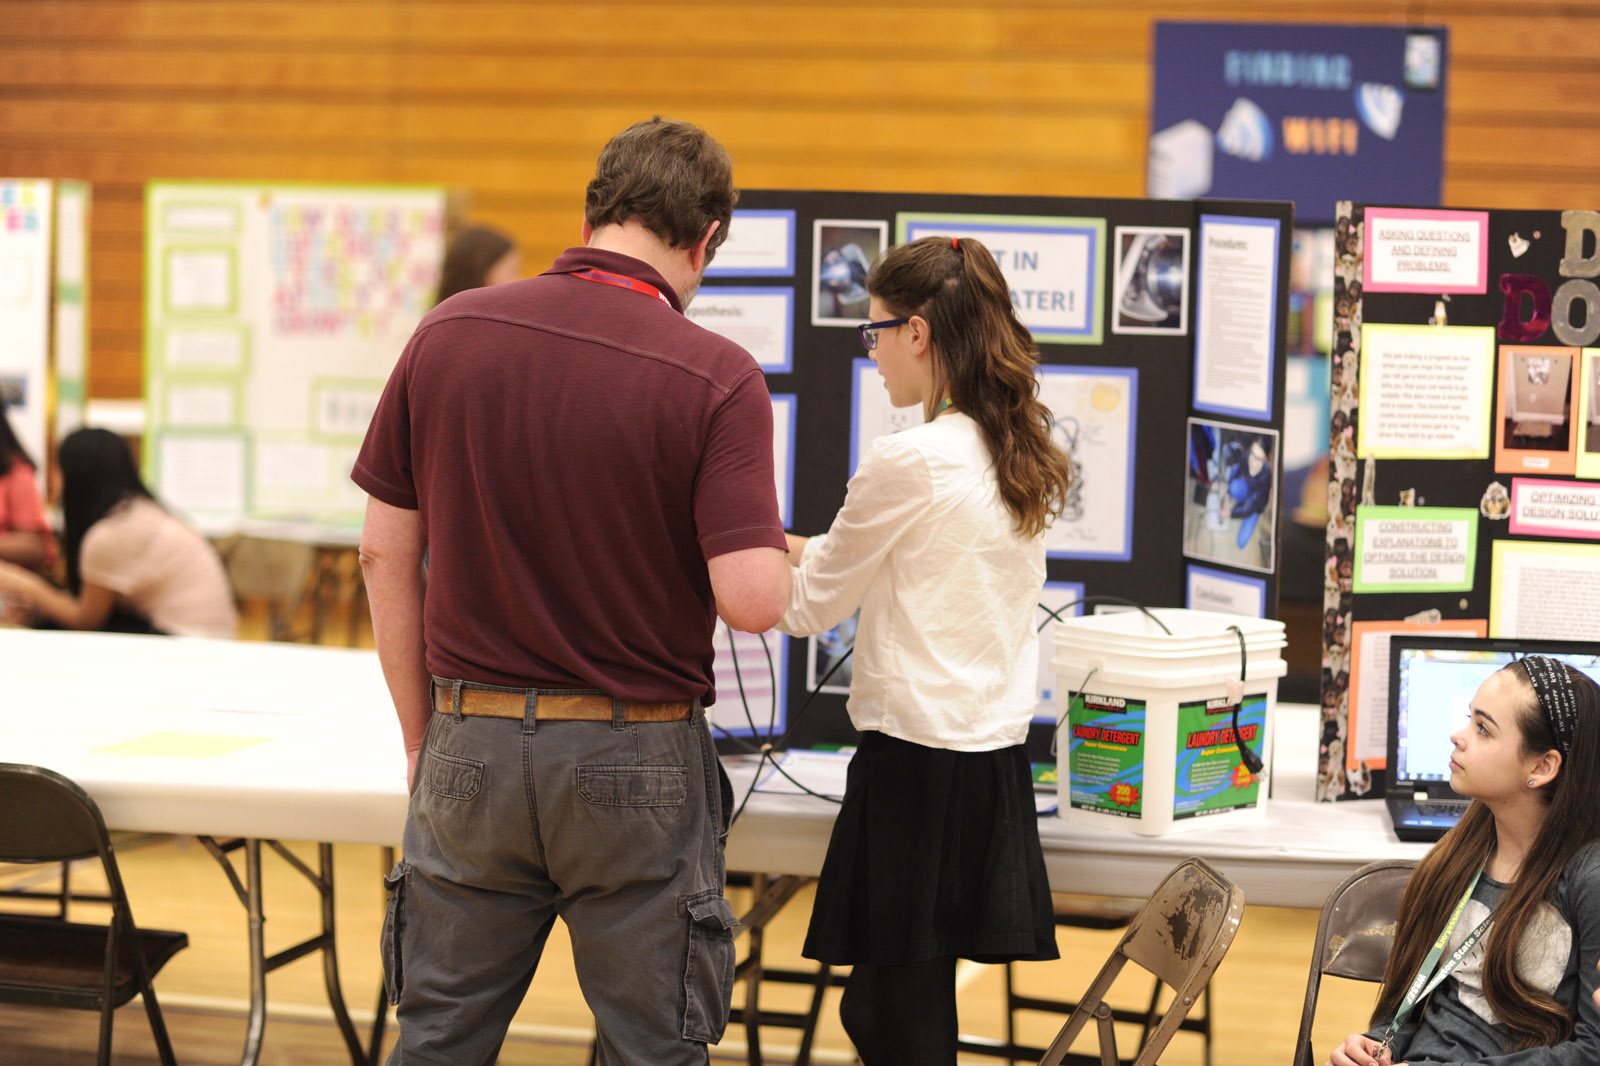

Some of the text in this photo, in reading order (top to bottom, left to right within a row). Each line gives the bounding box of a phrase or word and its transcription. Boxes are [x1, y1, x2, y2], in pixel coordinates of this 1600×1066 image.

[1224, 50, 1352, 90] FINDING
[1282, 117, 1358, 155] WIFI
[1379, 229, 1470, 242] ASKING QUESTIONS
[1391, 245, 1457, 258] AND DEFINING
[1014, 251, 1038, 270] IN
[1010, 290, 1074, 312] ATER!
[1530, 492, 1596, 506] OPTIMIZING
[1522, 506, 1600, 521] DESIGN SOLU
[1379, 521, 1453, 534] CONSTRUCTING
[1372, 536, 1458, 549] EXPLANATIONS TO
[1364, 551, 1466, 565] OPTIMIZE THE DESIGN
[1085, 694, 1126, 708] KIRKLAND
[1073, 724, 1141, 746] LAUNDRY DETERGENT
[1187, 730, 1220, 749] LAUNDRY
[1453, 937, 1475, 960] State
[1406, 973, 1426, 1005] WSSEF
